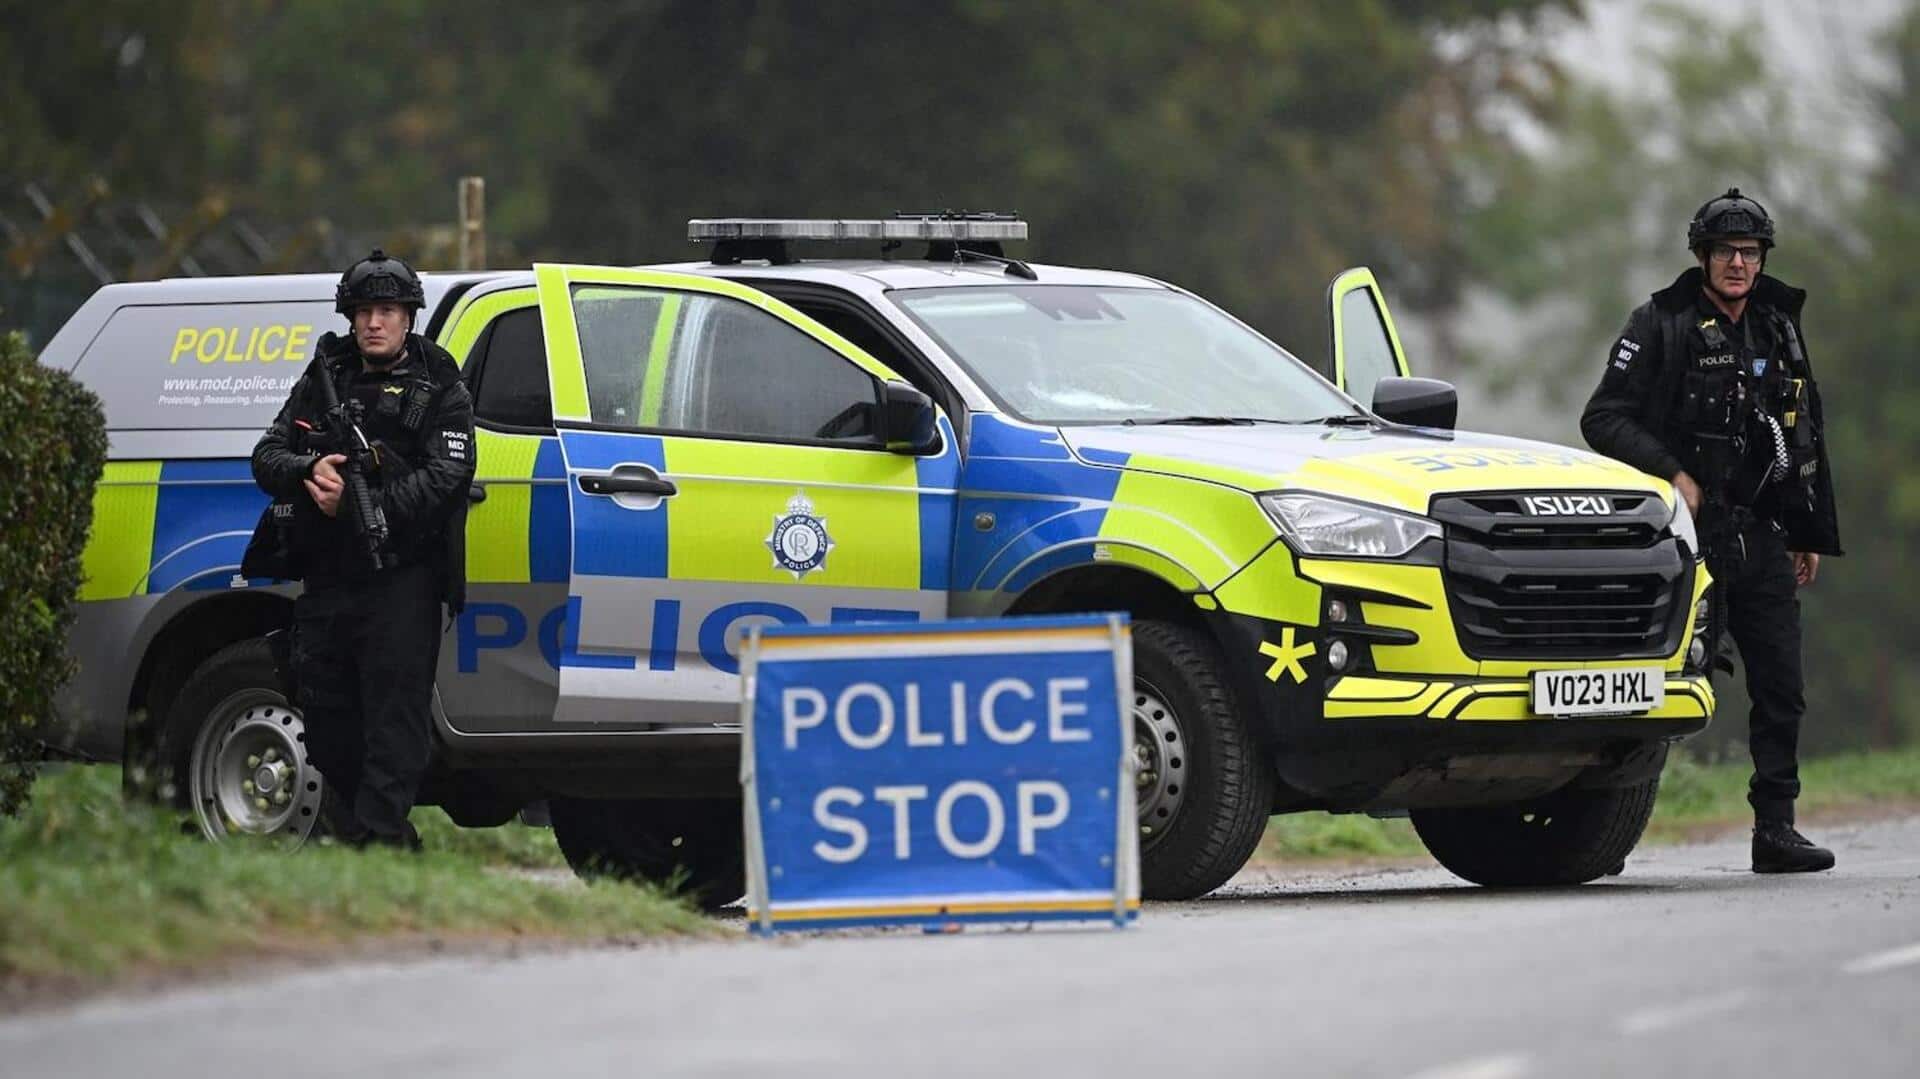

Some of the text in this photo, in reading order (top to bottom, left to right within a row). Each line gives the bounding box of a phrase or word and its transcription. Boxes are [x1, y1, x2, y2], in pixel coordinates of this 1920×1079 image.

[169, 325, 313, 364] POLICE
[1699, 354, 1735, 367] POLICE
[163, 375, 298, 393] www.mod.police.uk
[442, 431, 469, 440] POLICE
[447, 440, 465, 450] MD
[1524, 496, 1611, 516] ISUZU
[795, 516, 807, 525] OF
[783, 558, 815, 570] POLICE
[457, 596, 920, 676] PLIC
[1546, 671, 1655, 707] VO23 HXL
[781, 677, 1092, 751] POLICE
[812, 780, 1071, 864] STOP
